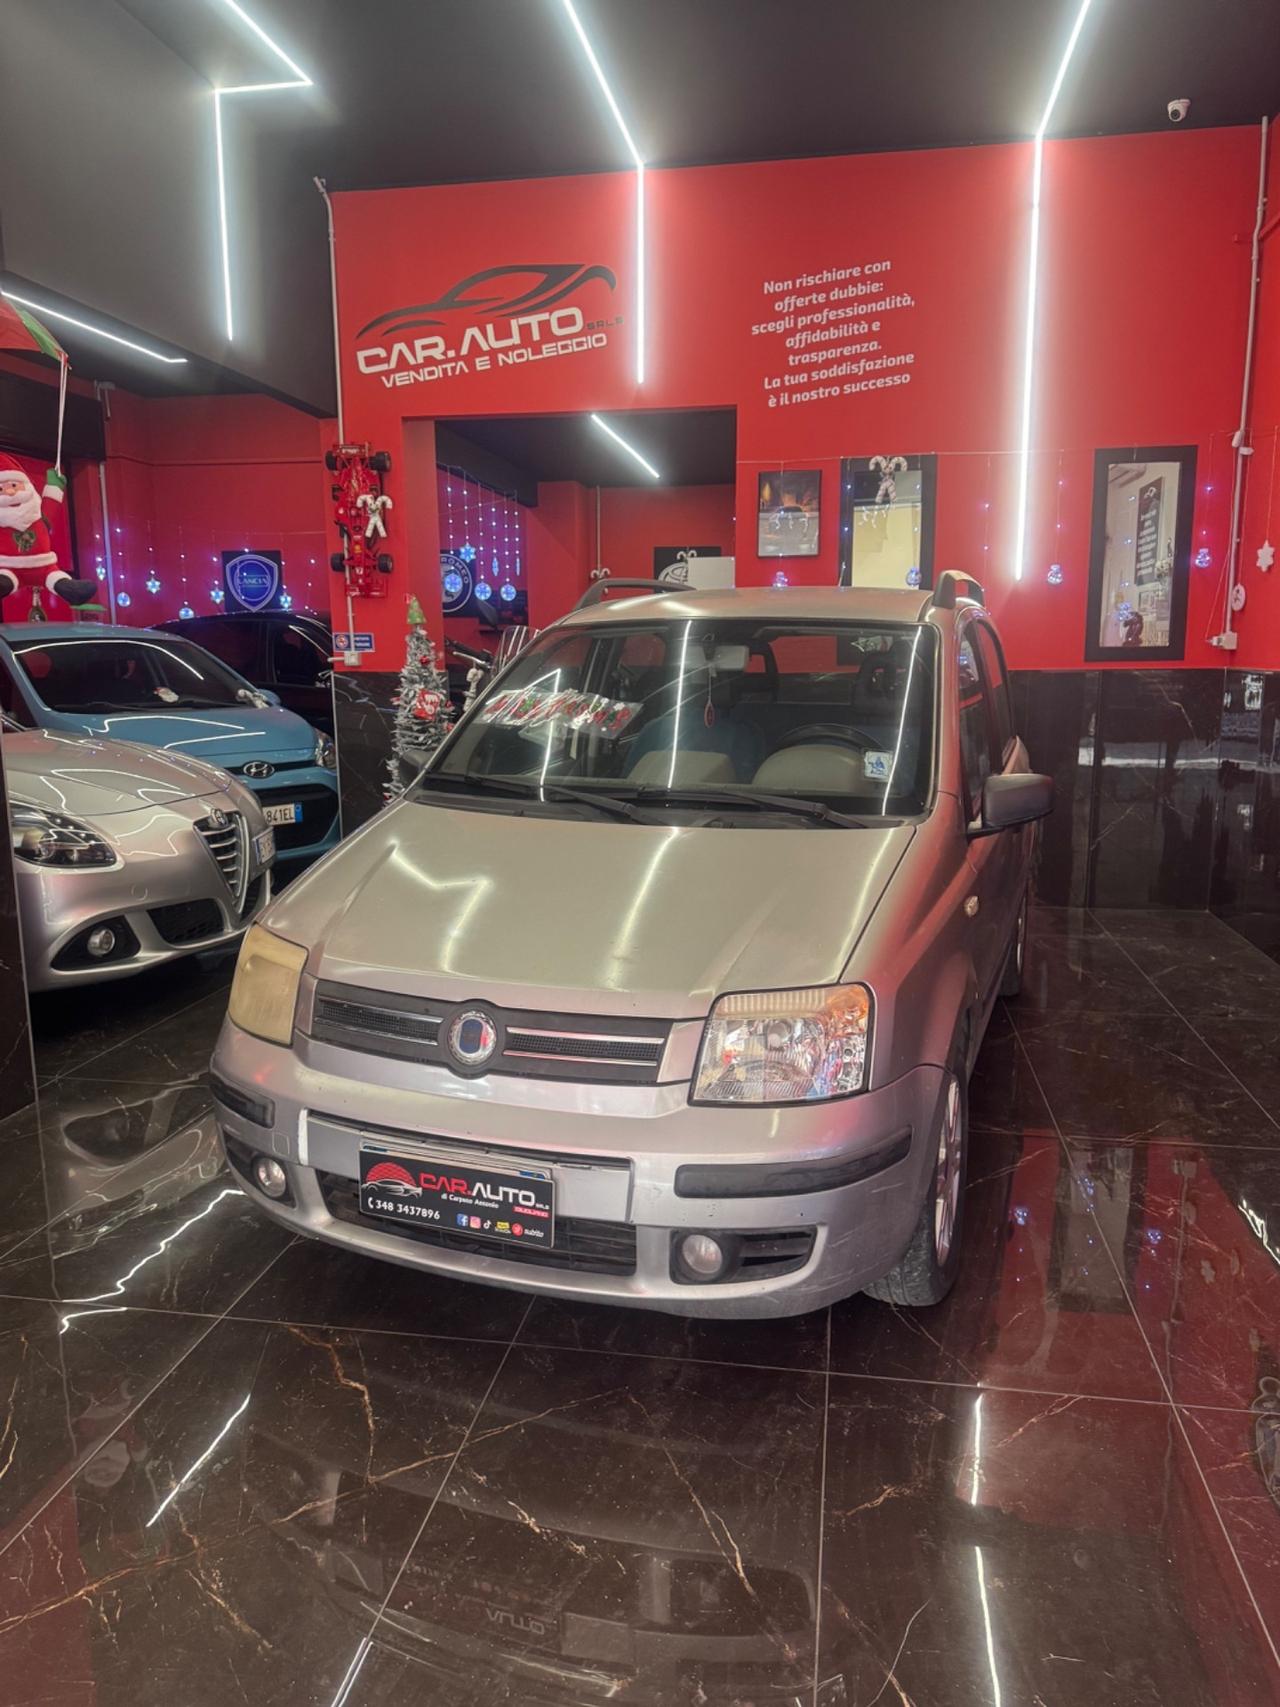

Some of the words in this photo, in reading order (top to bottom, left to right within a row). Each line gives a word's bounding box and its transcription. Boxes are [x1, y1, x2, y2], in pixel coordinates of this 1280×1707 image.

[763, 280, 793, 295] Non
[795, 265, 861, 288] rischiare
[864, 260, 891, 275] con
[751, 314, 794, 336] scegli
[797, 293, 915, 329] professionalità,
[774, 292, 826, 313] offerte
[829, 281, 884, 301] dubbie:
[785, 321, 868, 349] affidabilità
[871, 321, 881, 331] e
[381, 362, 469, 388] VENDITA
[475, 356, 491, 371] E
[497, 333, 608, 367] NOLEGGIO
[788, 340, 882, 366] trasparenza.
[764, 376, 781, 389] La
[784, 373, 808, 386] tua
[811, 353, 915, 381] soddisfazione
[768, 394, 777, 408] è
[779, 393, 790, 406] il
[792, 385, 840, 404] nostro
[843, 373, 911, 394] successo
[375, 1199, 394, 1212] 348
[396, 1203, 441, 1220] 3437896
